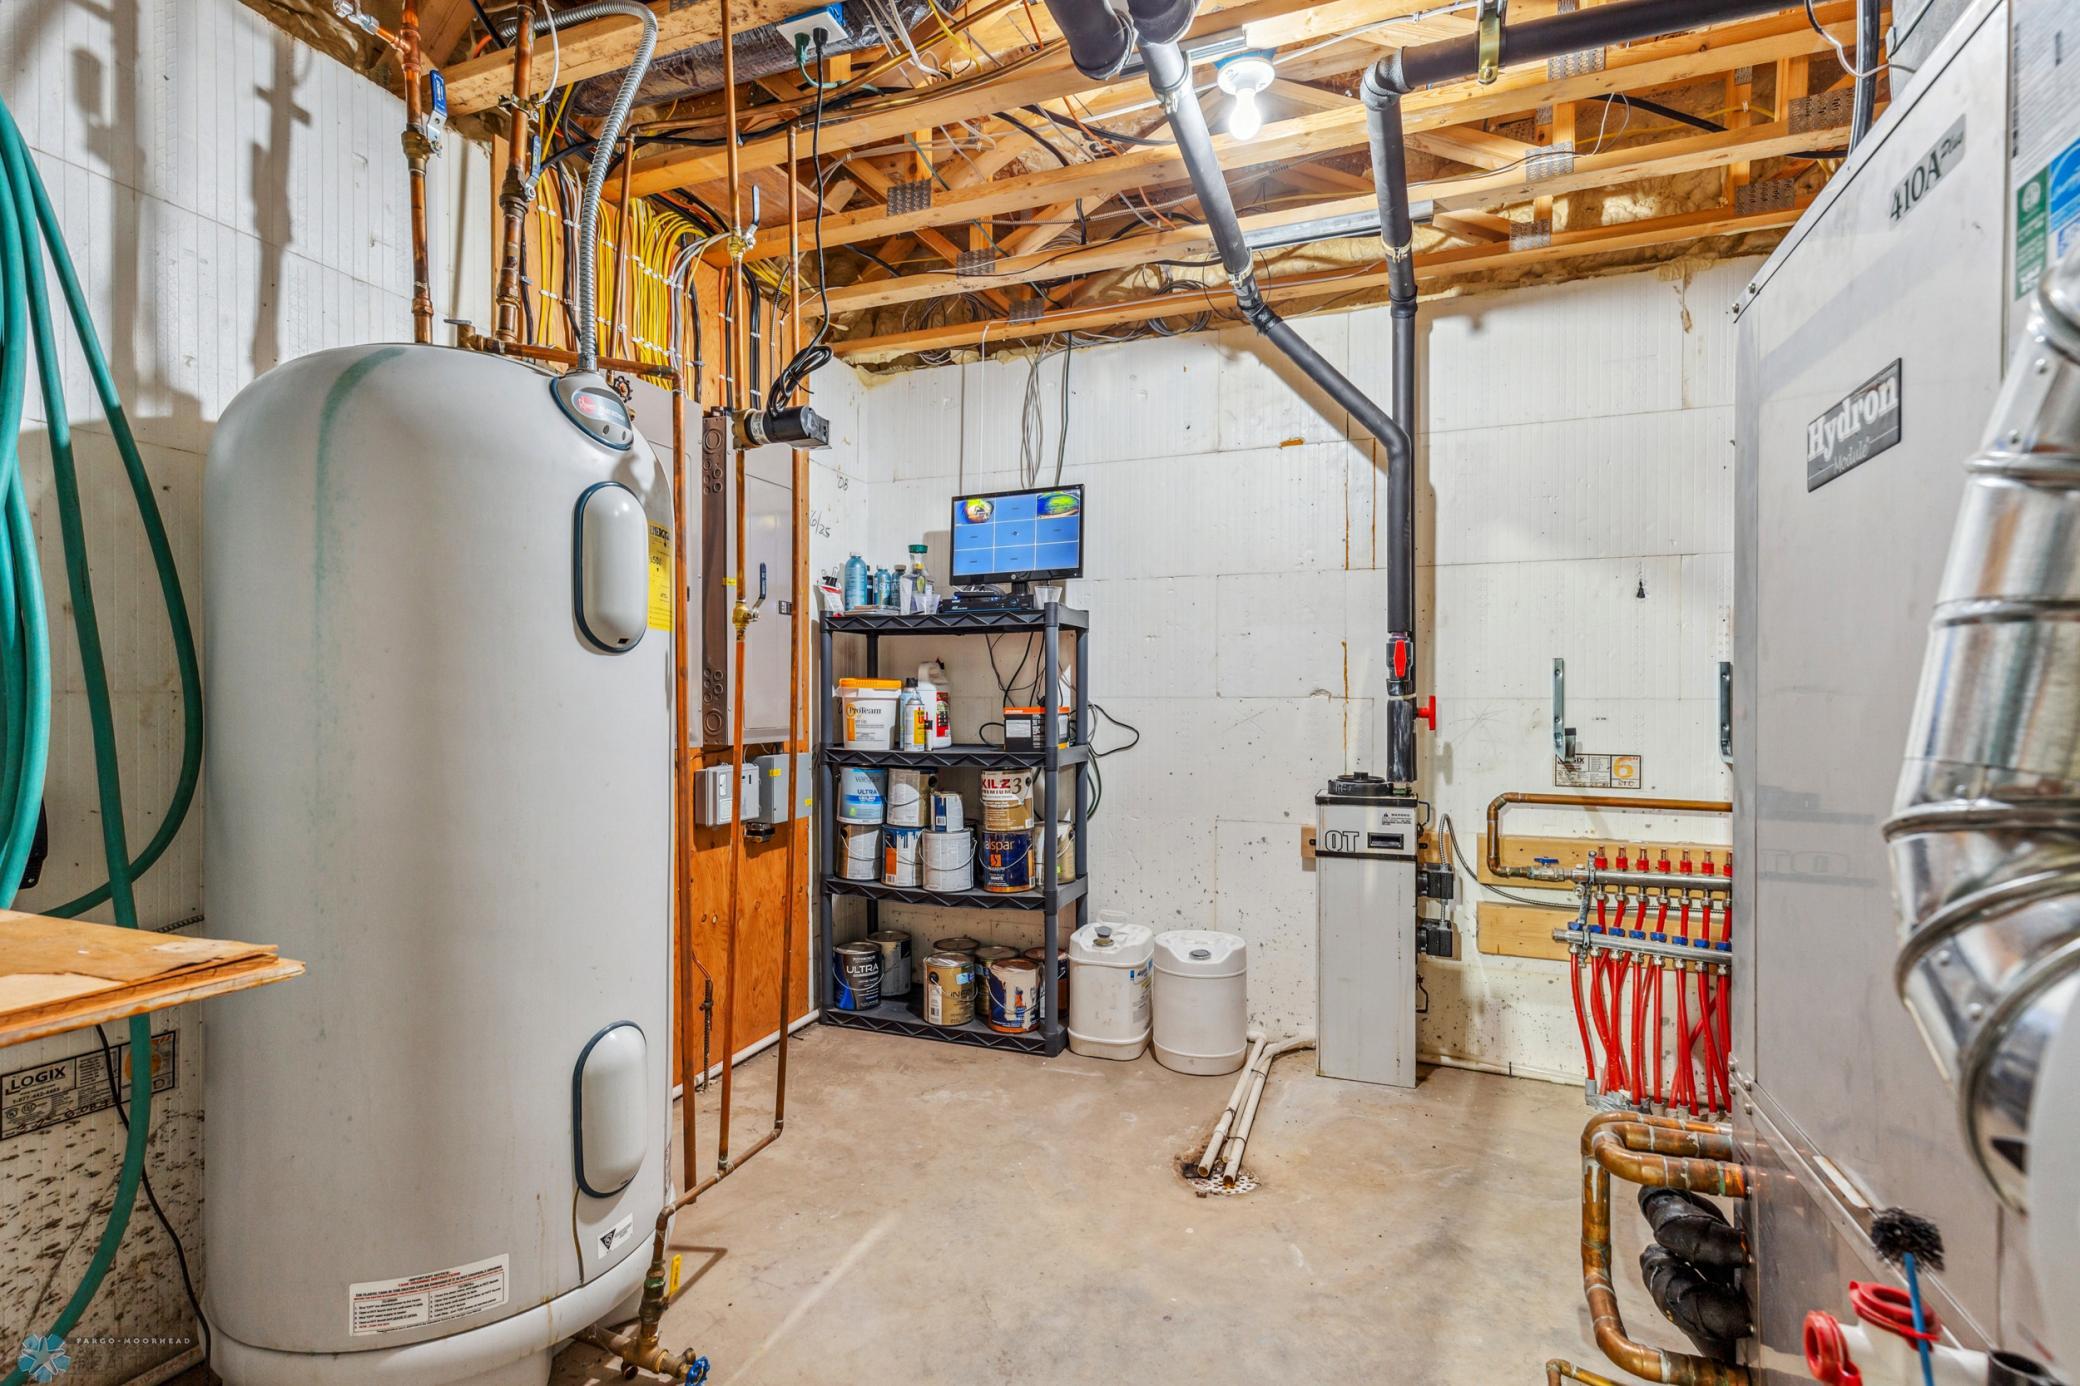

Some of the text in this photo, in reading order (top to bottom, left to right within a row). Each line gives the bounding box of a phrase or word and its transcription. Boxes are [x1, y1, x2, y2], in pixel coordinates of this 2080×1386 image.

[1890, 149, 1942, 222] 410A
[1808, 376, 1898, 463] Hydron
[849, 706, 882, 715] ProTeam
[1012, 777, 1022, 795] 3
[984, 838, 1015, 852] alspar
[846, 962, 879, 974] ULTRA
[11, 1065, 66, 1091] LOGIX
